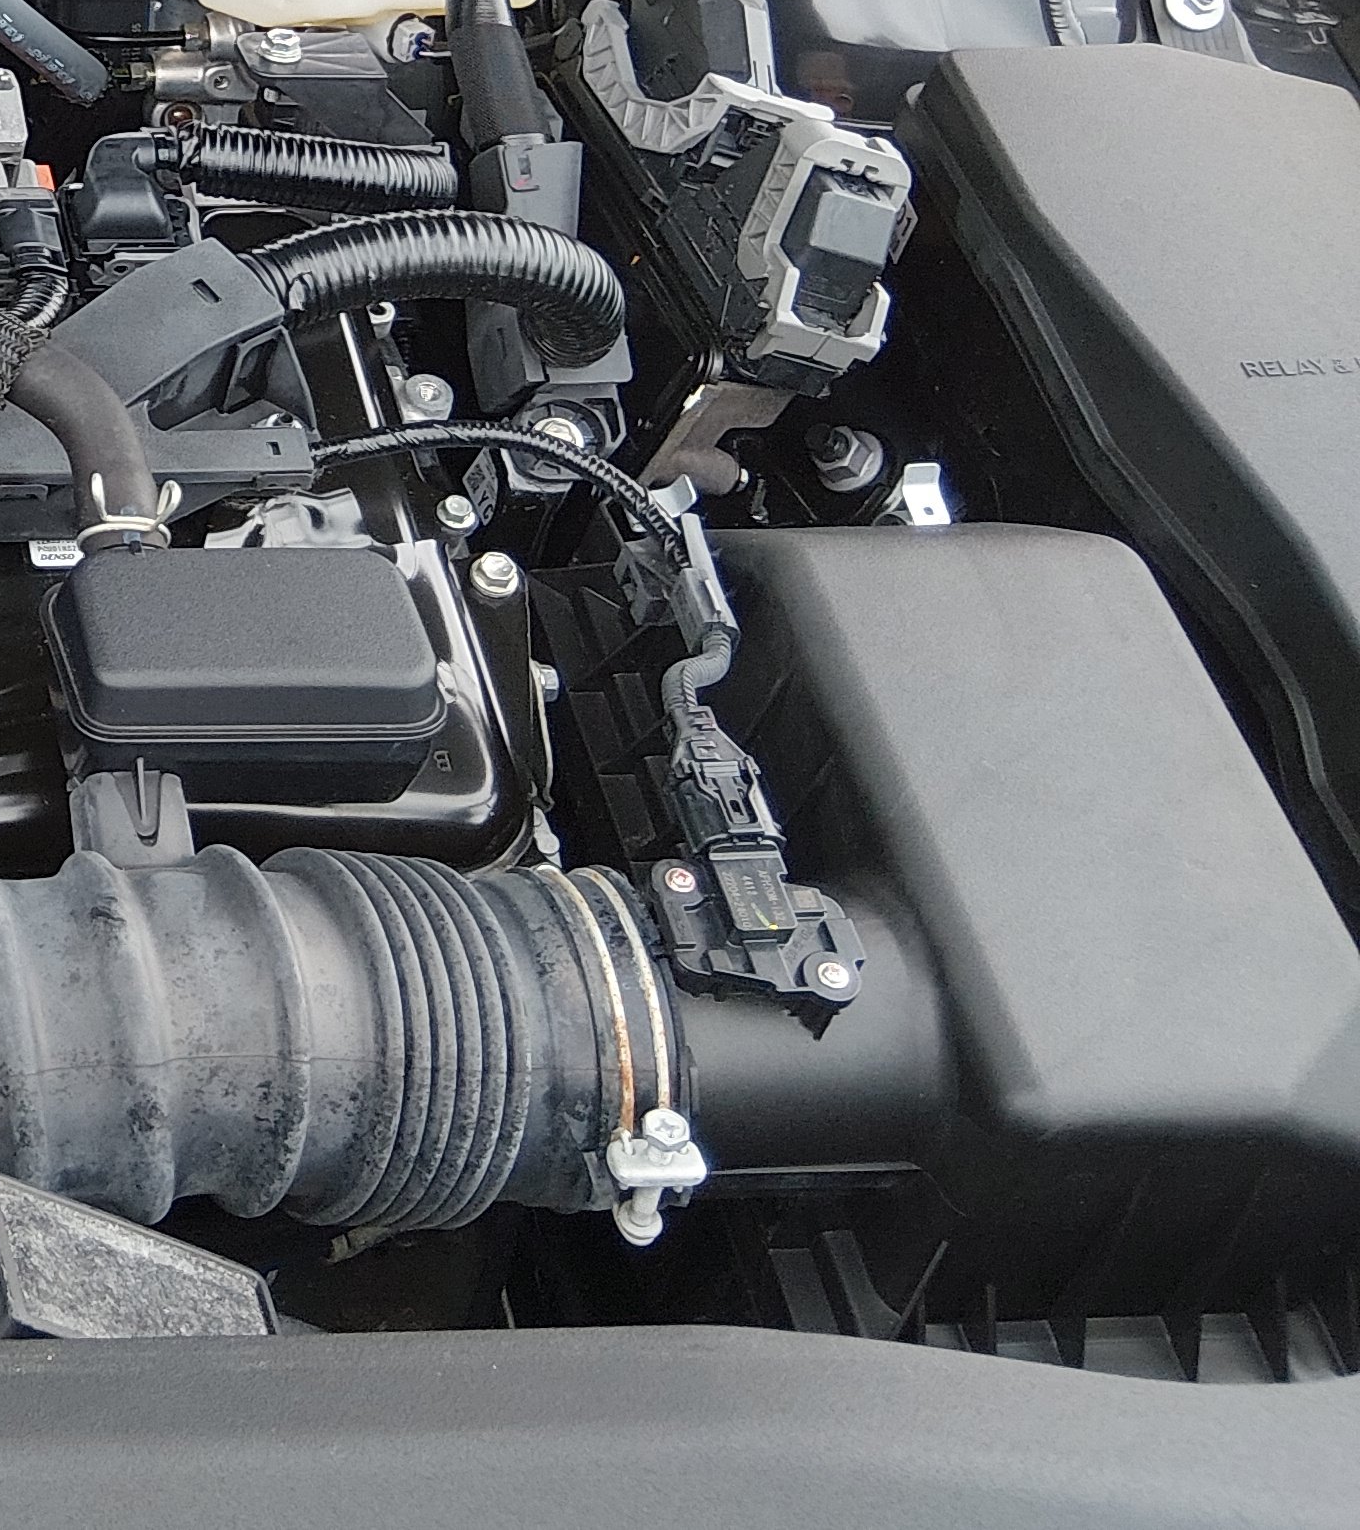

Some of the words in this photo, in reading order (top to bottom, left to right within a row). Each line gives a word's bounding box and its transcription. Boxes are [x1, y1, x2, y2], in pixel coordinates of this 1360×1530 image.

[1240, 356, 1327, 379] RELAY
[1331, 358, 1353, 375] &
[40, 553, 76, 561] DENSO
